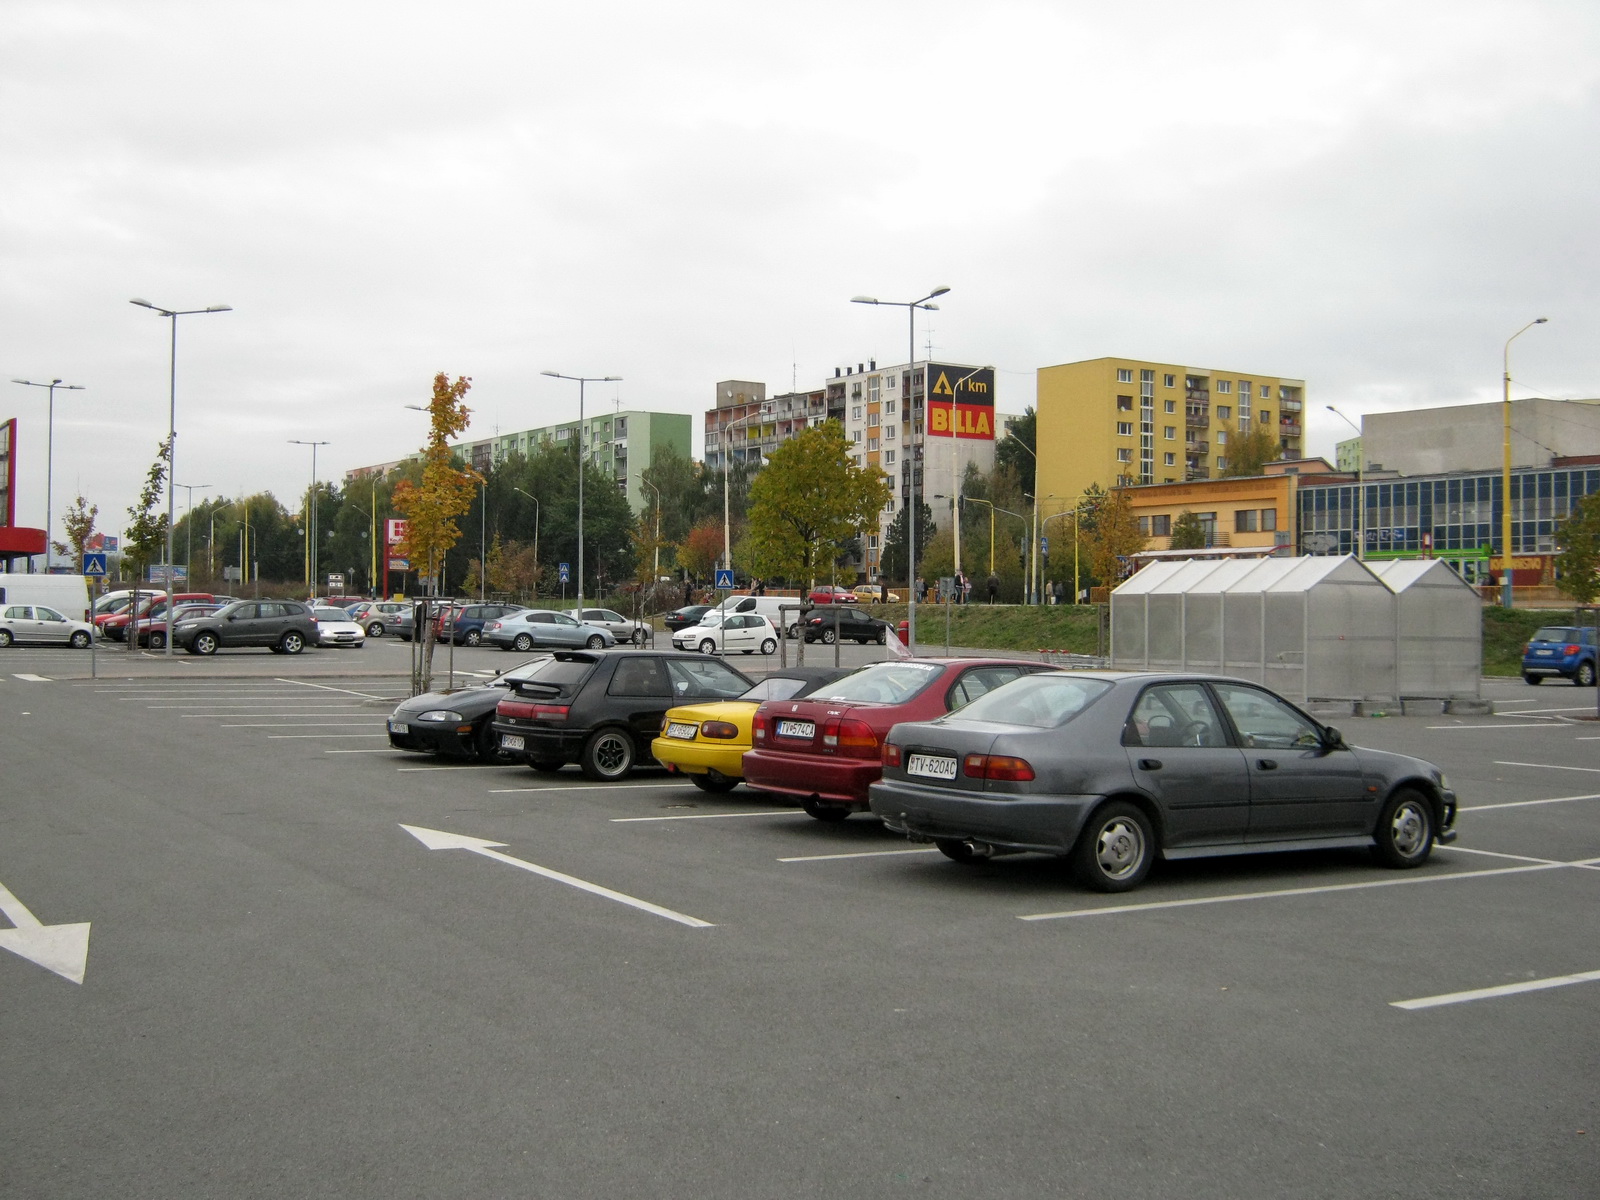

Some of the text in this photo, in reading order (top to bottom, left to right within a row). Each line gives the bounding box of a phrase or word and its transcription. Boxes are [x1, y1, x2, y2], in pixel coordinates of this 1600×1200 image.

[968, 378, 987, 393] km
[932, 407, 991, 435] BILLA
[915, 757, 956, 775] TV-620AC
